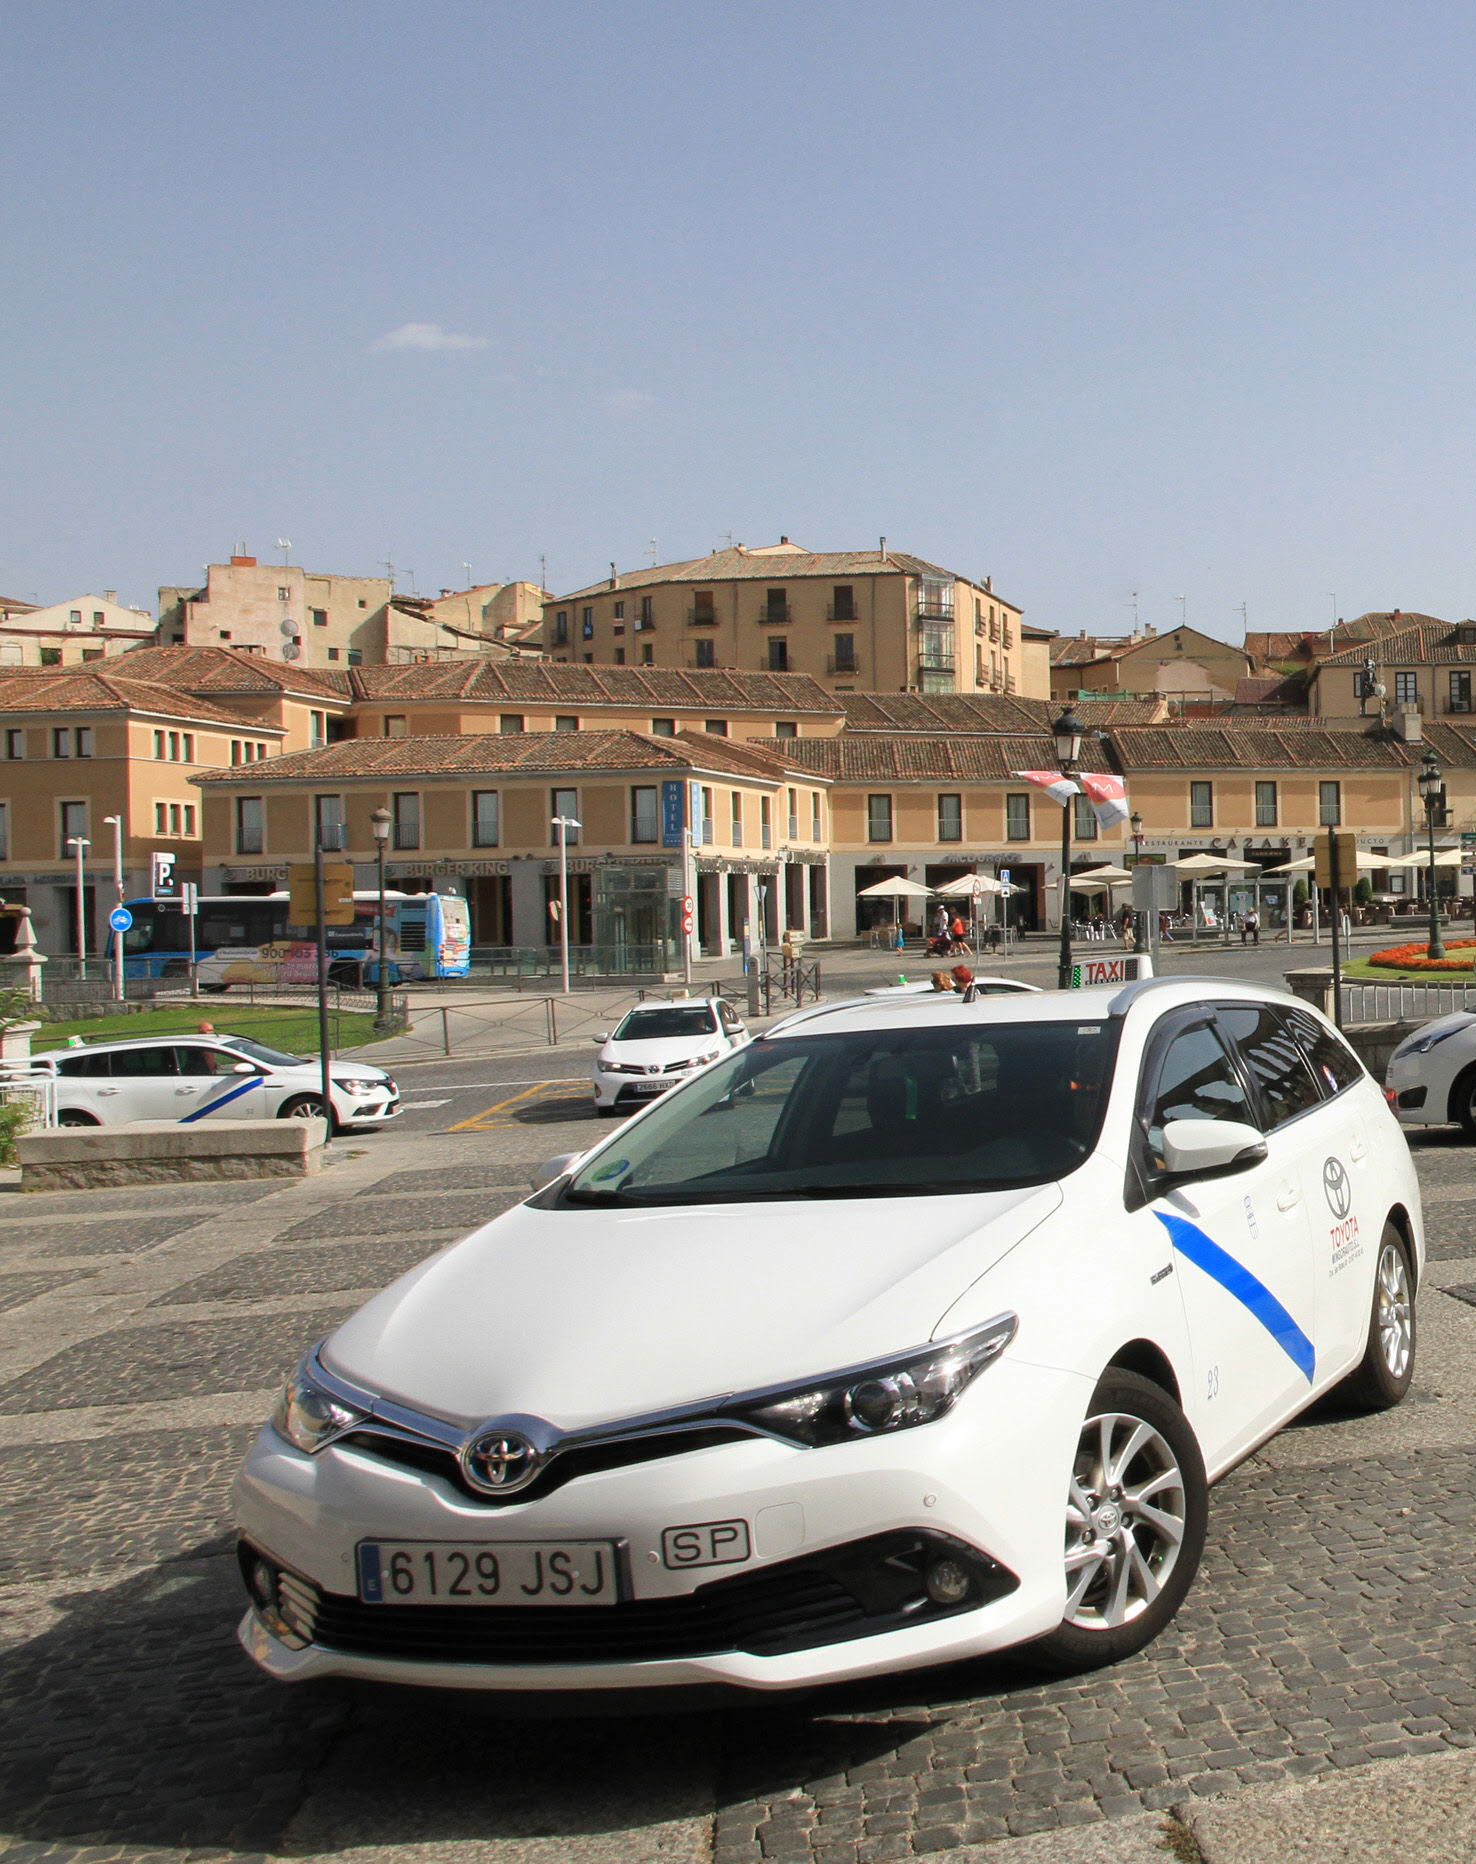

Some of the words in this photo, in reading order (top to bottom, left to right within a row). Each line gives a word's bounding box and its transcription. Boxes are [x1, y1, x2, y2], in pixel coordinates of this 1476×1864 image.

[669, 784, 677, 831] HOTEL
[406, 863, 467, 876] BURGER
[470, 861, 509, 875] KING
[1085, 960, 1125, 981] TAXI
[1330, 1216, 1359, 1251] TOYOTA
[672, 1527, 739, 1562] SP
[389, 1551, 500, 1596] 6129
[521, 1551, 605, 1596] JSJ
